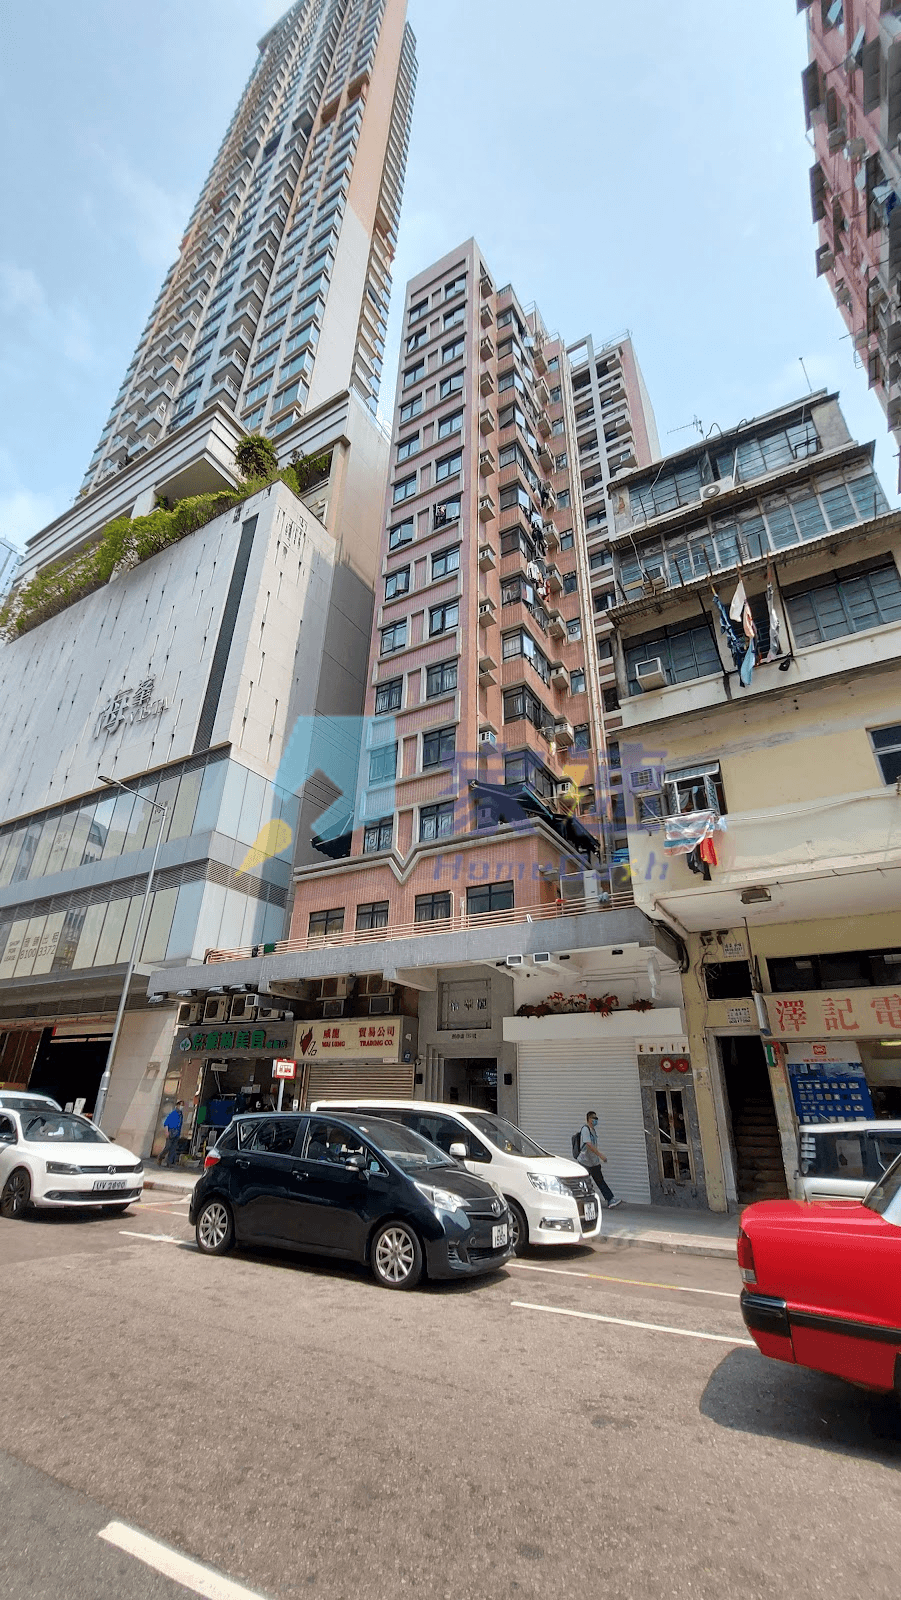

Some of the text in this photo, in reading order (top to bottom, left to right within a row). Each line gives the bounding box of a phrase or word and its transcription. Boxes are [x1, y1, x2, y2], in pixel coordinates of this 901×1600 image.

[776, 994, 901, 1032] 澤記電
[359, 1026, 395, 1038] 貿易公司
